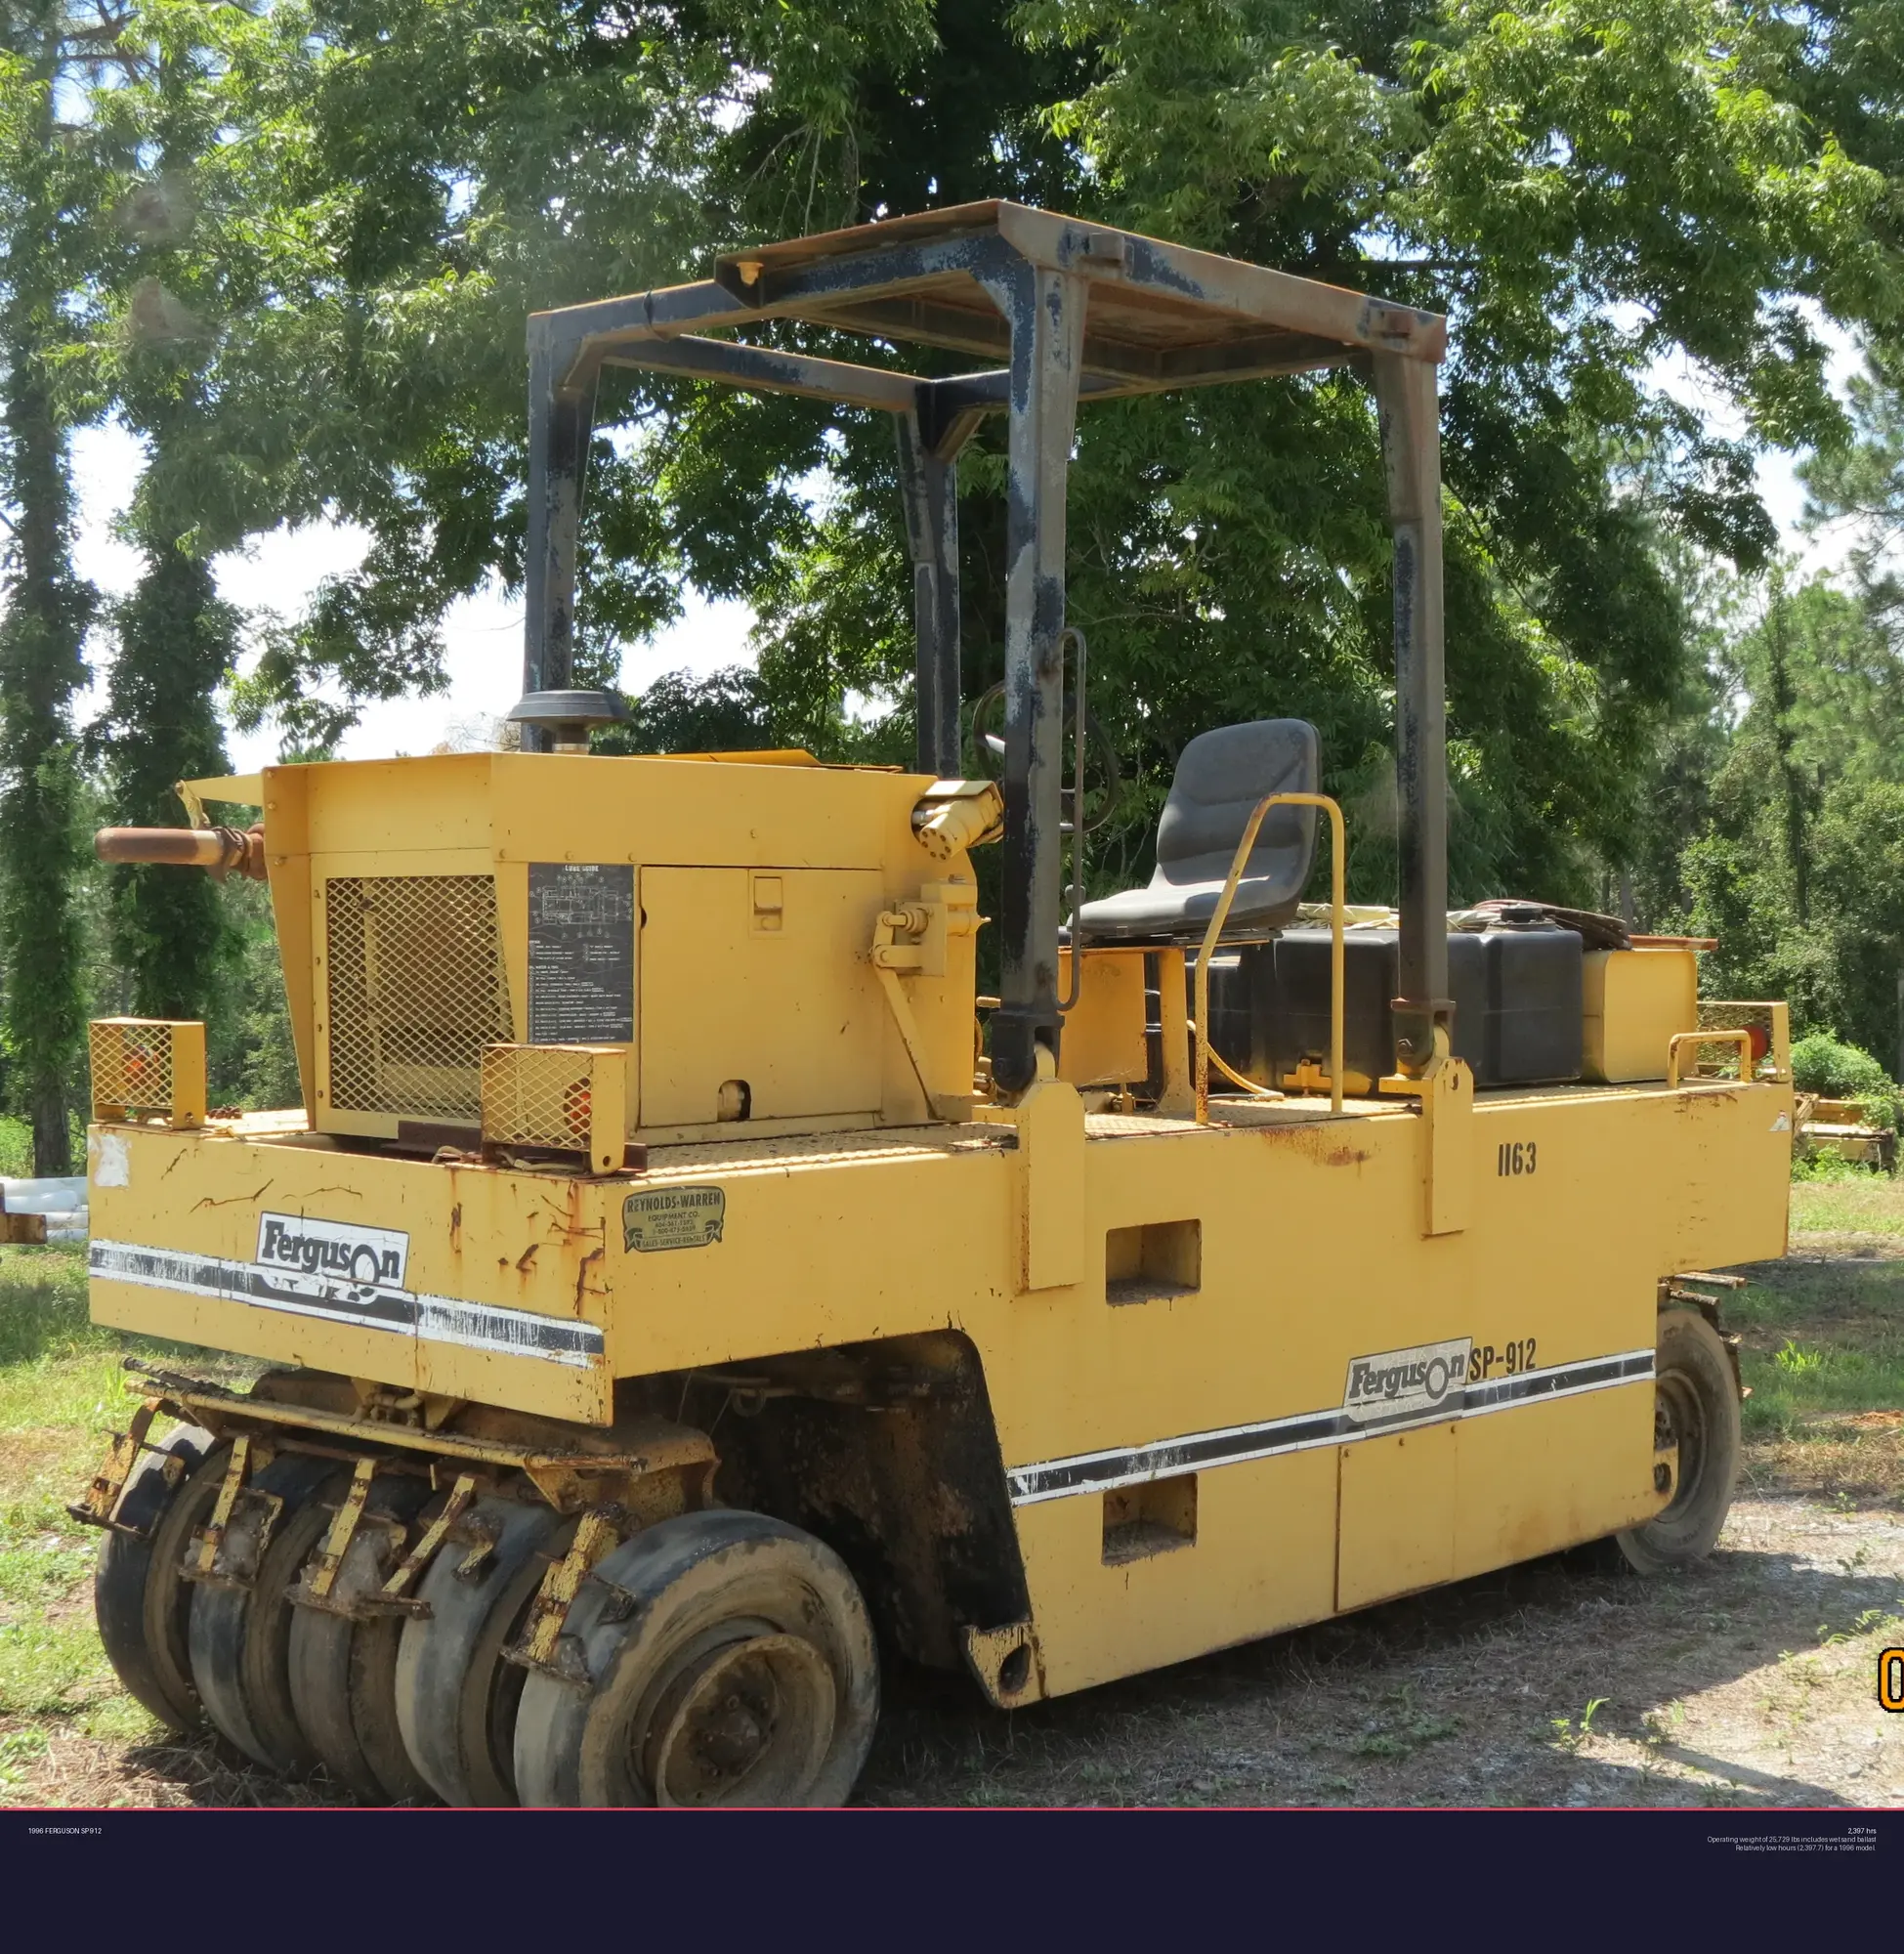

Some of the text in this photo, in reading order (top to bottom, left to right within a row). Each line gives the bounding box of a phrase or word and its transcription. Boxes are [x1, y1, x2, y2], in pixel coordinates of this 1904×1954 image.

[1498, 1141, 1537, 1177] 1163
[648, 1211, 700, 1222] EQUIPMENT CO.
[1469, 1338, 1537, 1381] SP-912
